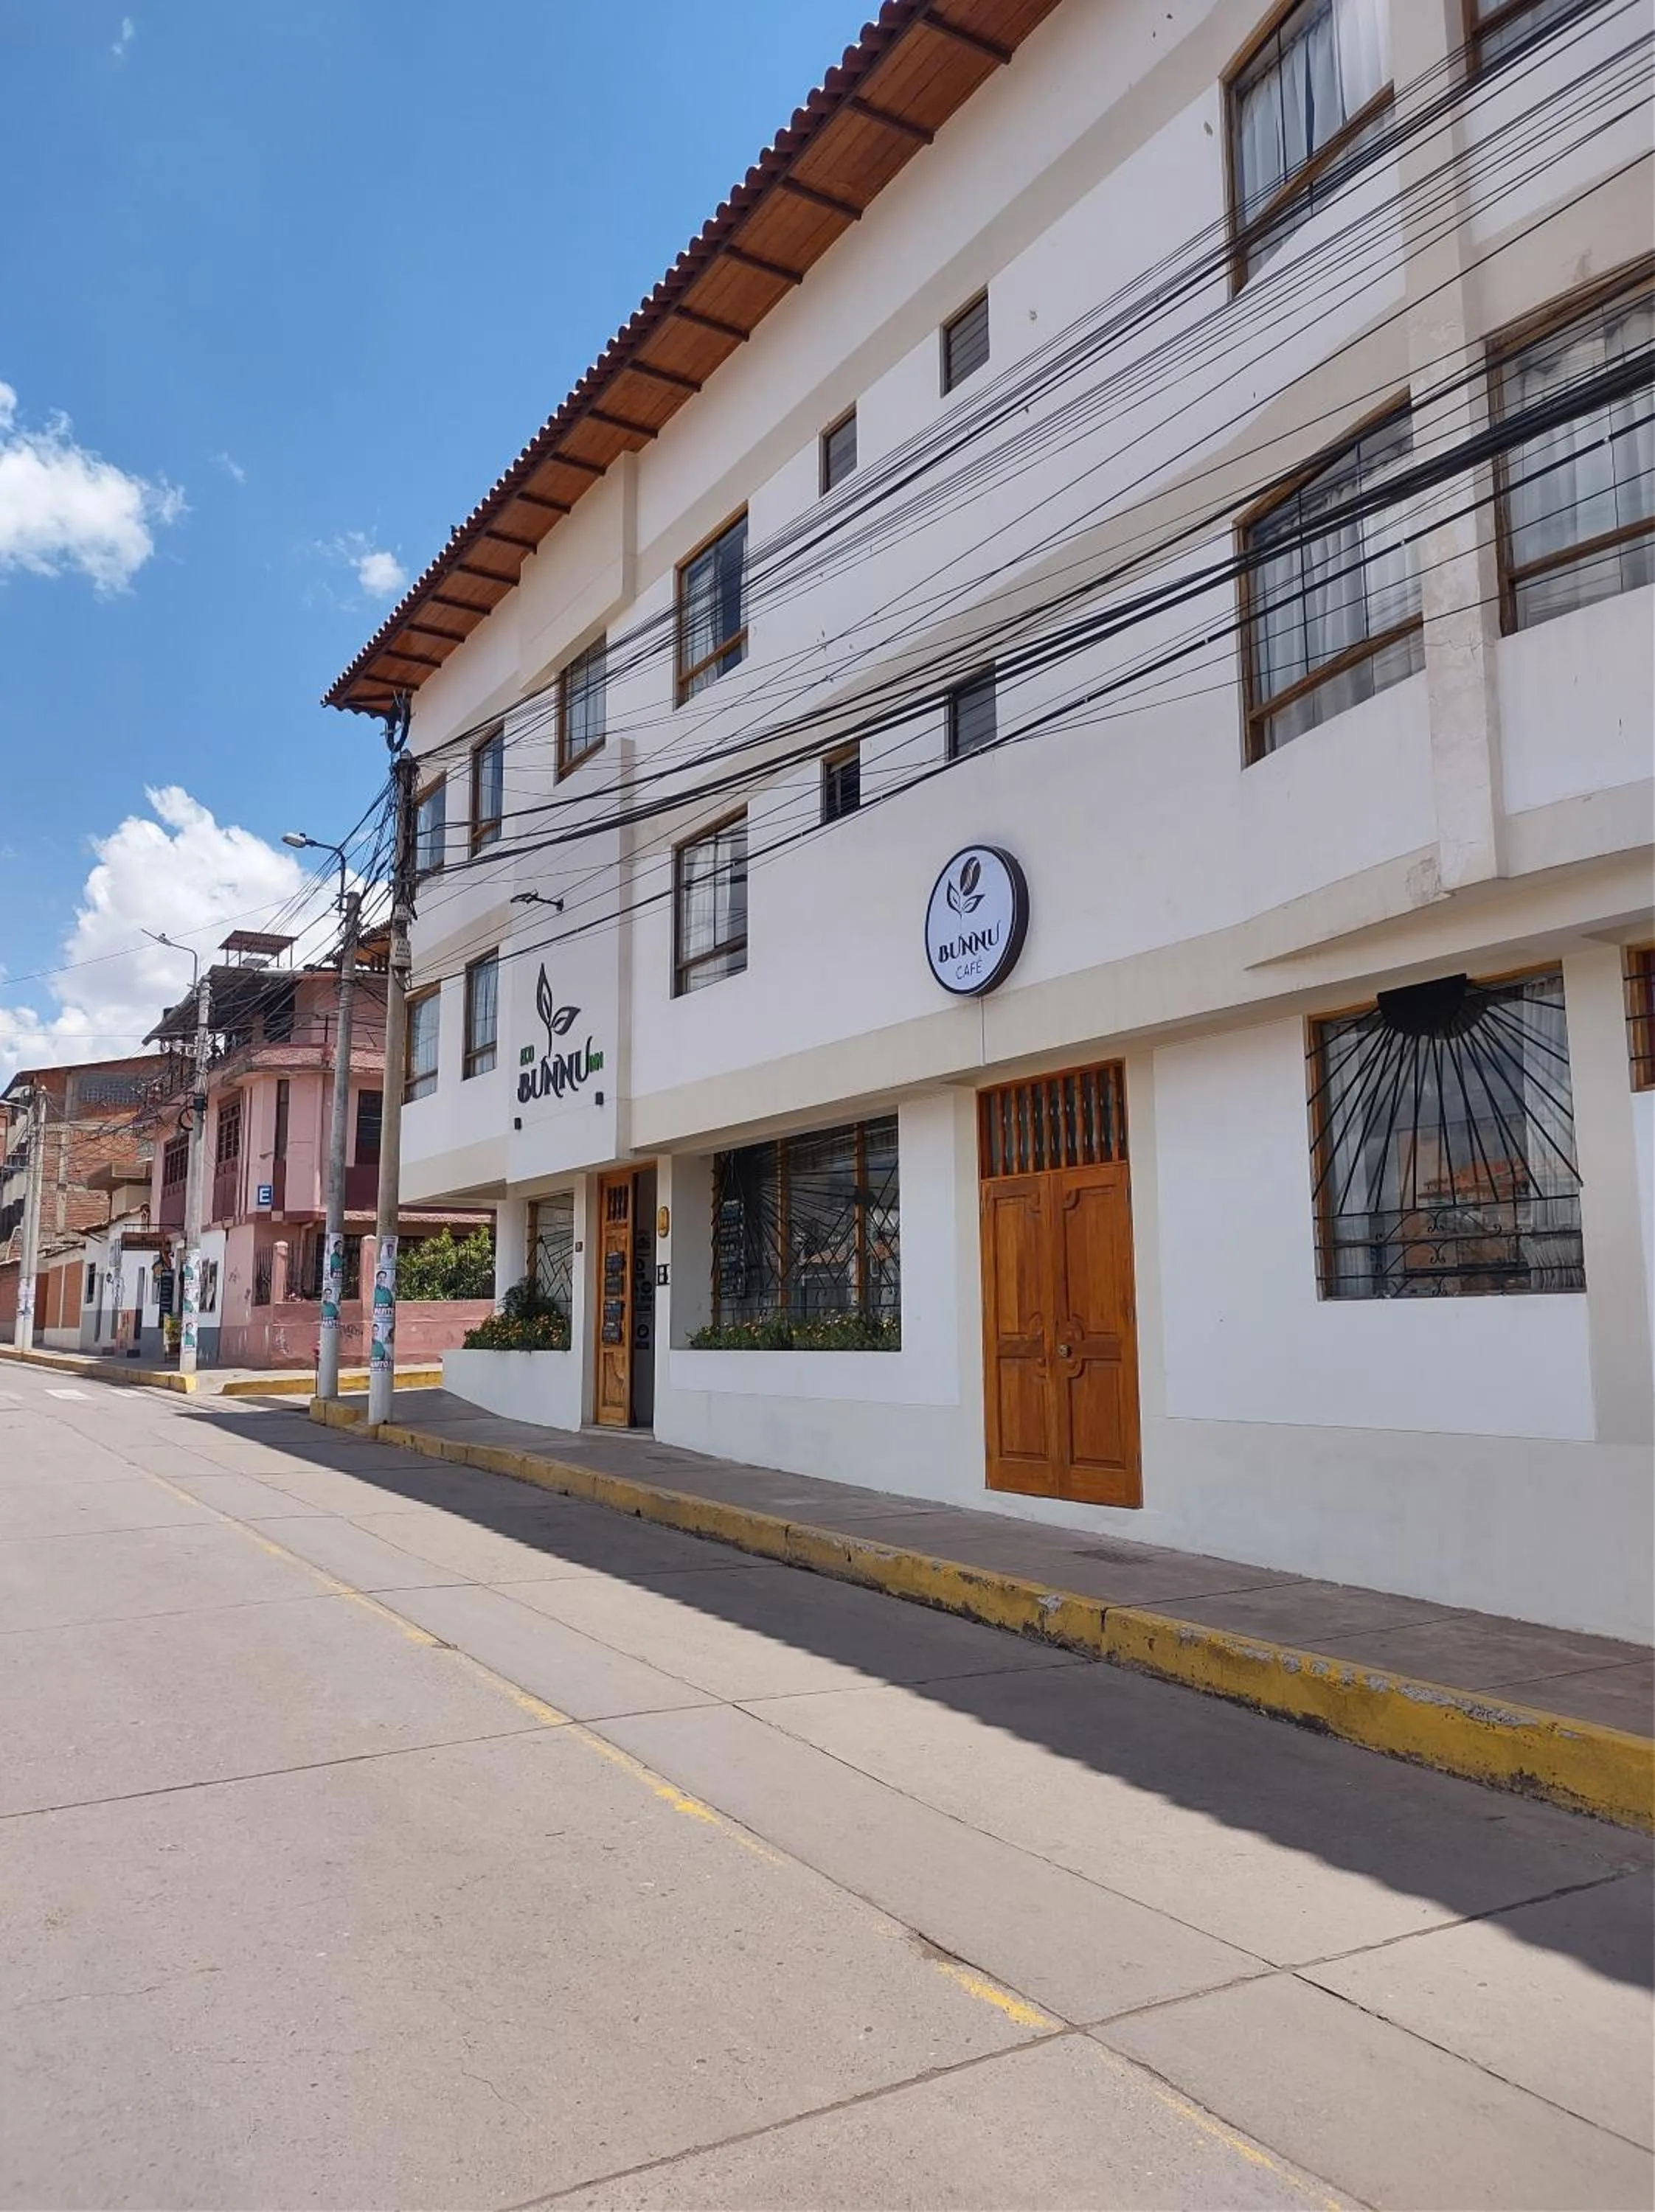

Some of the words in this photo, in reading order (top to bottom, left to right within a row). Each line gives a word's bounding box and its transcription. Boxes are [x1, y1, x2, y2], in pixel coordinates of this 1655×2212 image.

[938, 920, 1001, 963] BUNNU
[955, 956, 982, 979] CAFÉ
[518, 1035, 592, 1102] BUNNU
[260, 1188, 270, 1202] E
